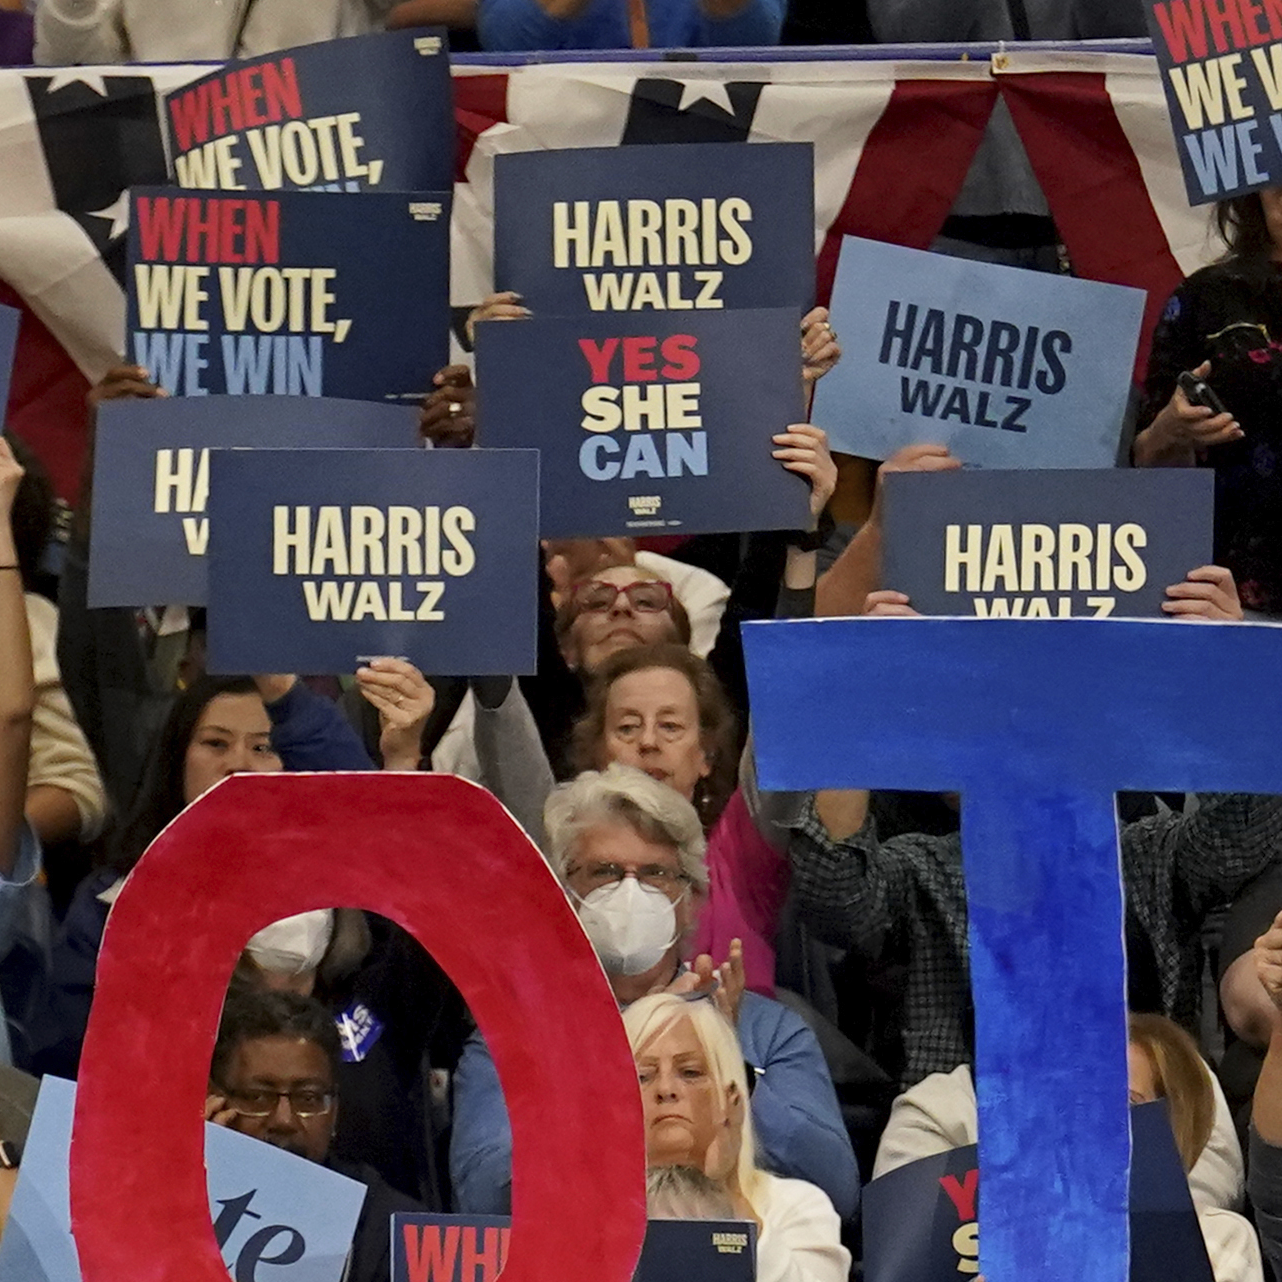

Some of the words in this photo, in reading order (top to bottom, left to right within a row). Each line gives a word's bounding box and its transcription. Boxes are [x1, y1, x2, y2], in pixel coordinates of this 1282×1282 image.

[168, 57, 303, 150] WHEN
[1170, 59, 1249, 130] WE
[174, 133, 245, 190] WE
[252, 112, 384, 187] VOTE,
[1182, 123, 1269, 197] WE
[137, 197, 280, 264] WHEN
[553, 198, 753, 269] HARRIS
[135, 265, 209, 331] WE
[220, 267, 353, 343] VOTE,
[584, 272, 724, 311] WALZ
[134, 332, 209, 397] WE
[219, 333, 323, 397] WIN
[578, 334, 701, 384] YES
[878, 300, 1073, 396] HARRIS
[579, 382, 702, 433] SHE
[899, 376, 1033, 434] WALZ
[579, 431, 708, 482] CAN
[273, 505, 476, 577] HARRIS
[944, 523, 1148, 593] HARRIS
[303, 581, 446, 622] WALZ
